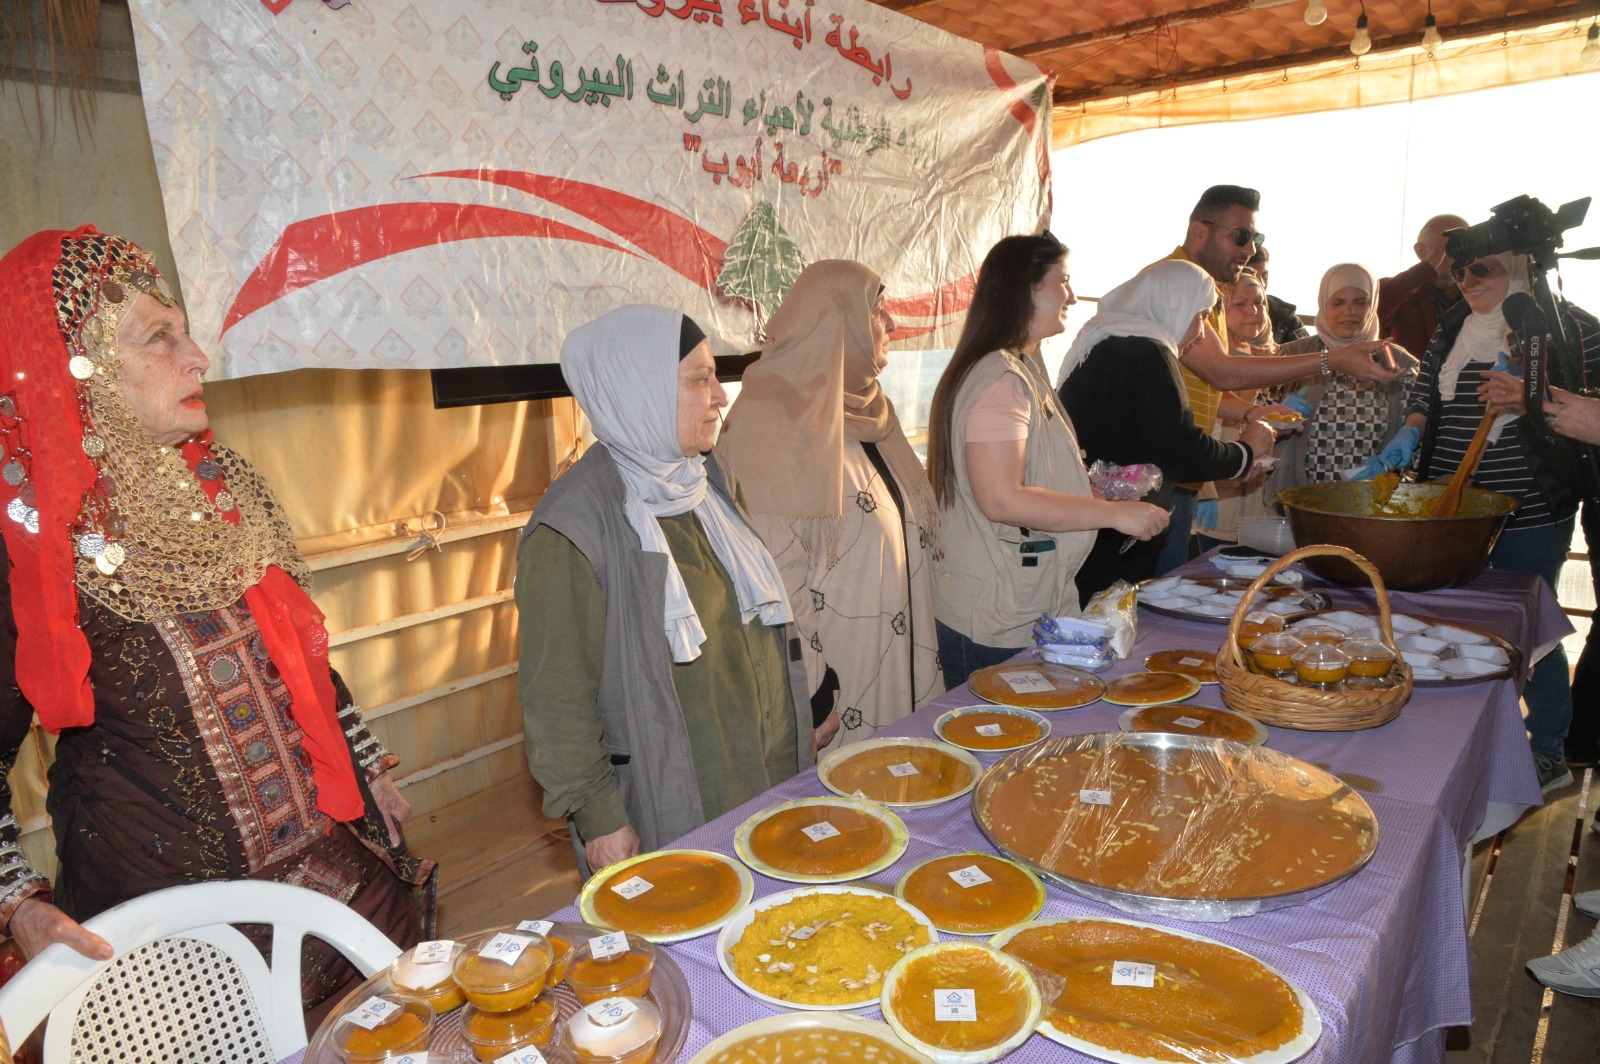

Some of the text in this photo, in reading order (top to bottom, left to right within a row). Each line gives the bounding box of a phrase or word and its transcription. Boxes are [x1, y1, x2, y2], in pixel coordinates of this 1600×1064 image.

[488, 40, 633, 107] البيروتي
[597, 0, 913, 99] رابطة أبناء بيرو
[646, 63, 732, 123] التراث
[1529, 335, 1540, 398] EOS DIGITAL
